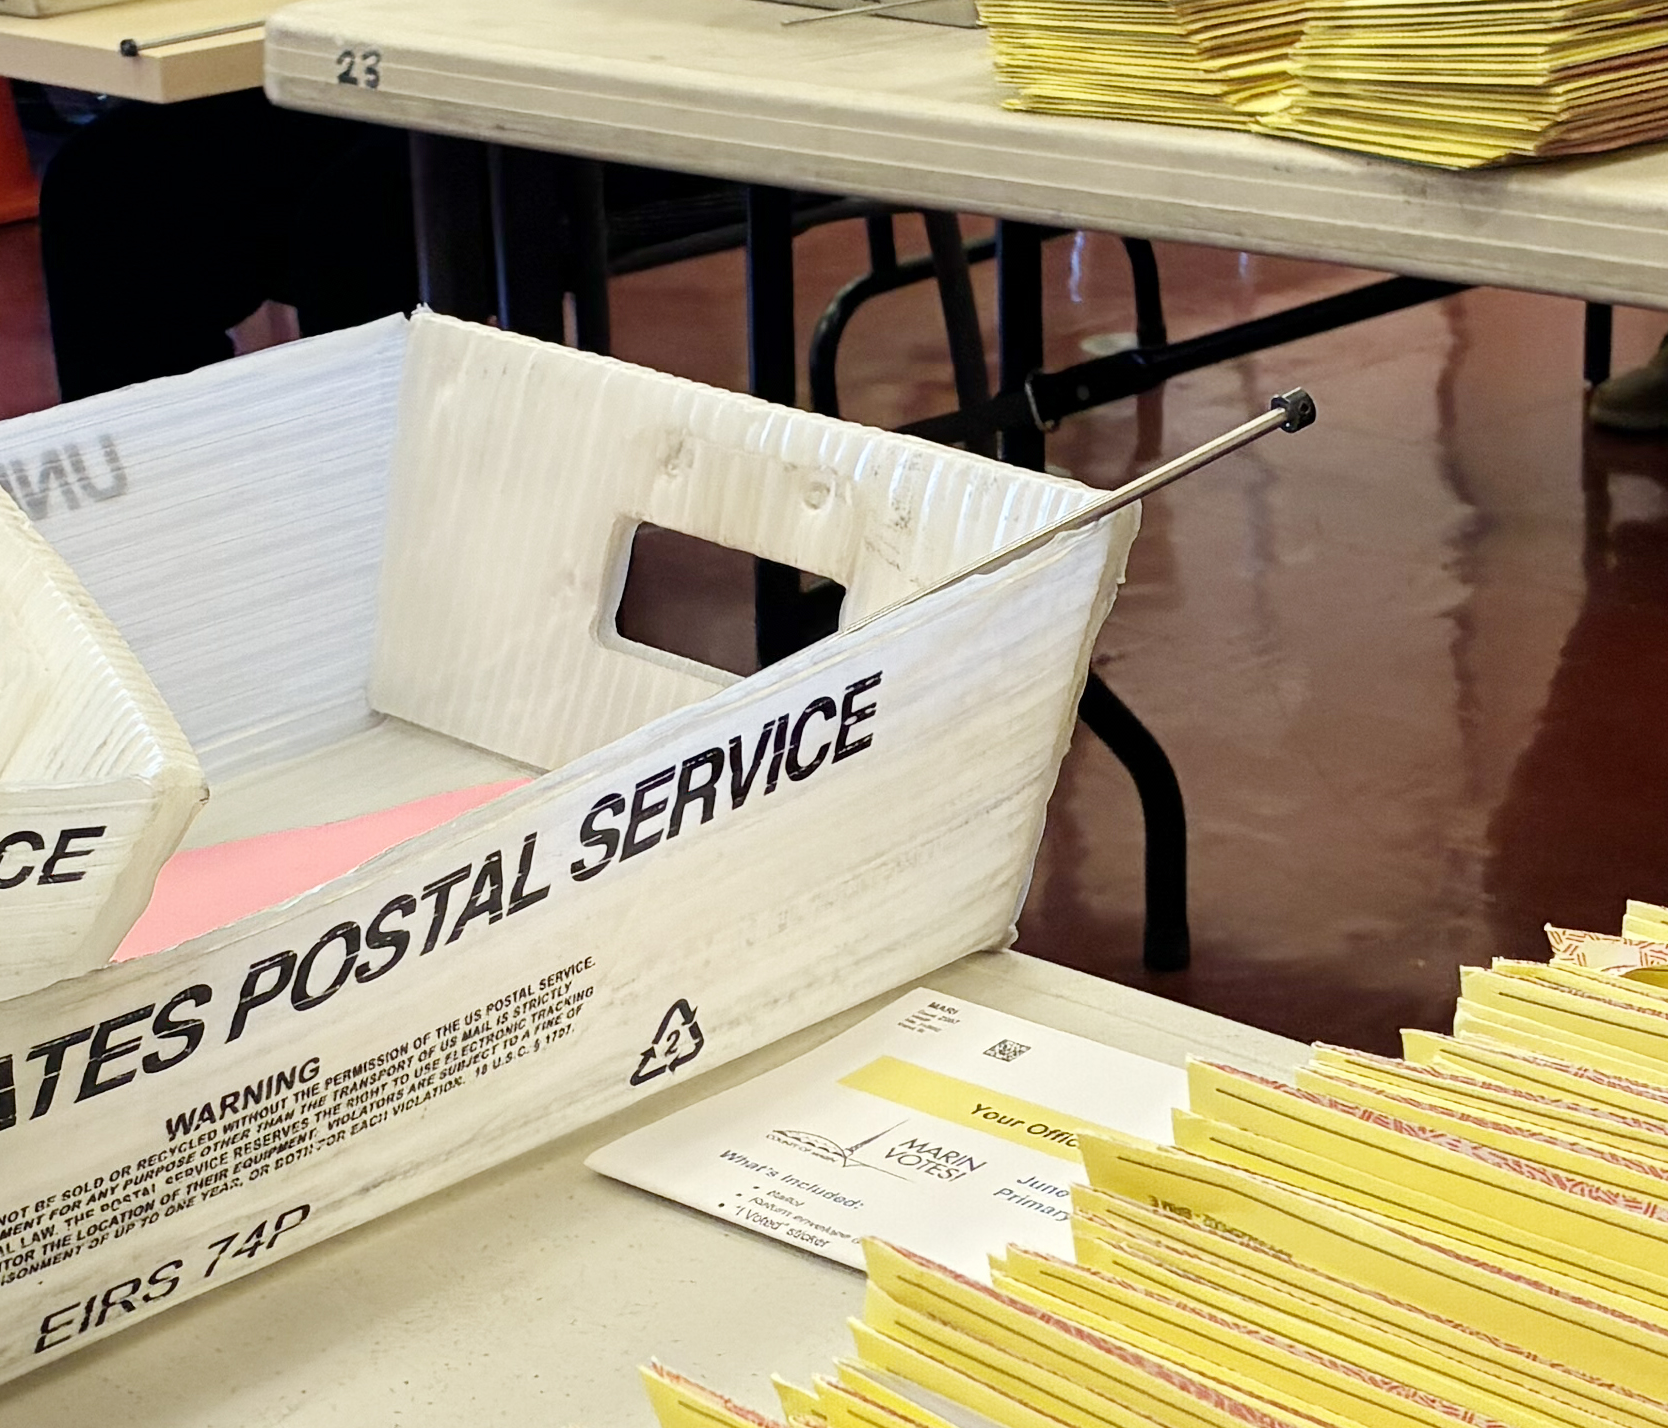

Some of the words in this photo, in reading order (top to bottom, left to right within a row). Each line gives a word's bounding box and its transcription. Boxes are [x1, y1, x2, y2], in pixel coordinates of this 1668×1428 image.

[334, 50, 382, 90] 23
[224, 830, 553, 1045] POSTAL
[570, 670, 884, 881] SERVICE
[665, 1029, 680, 1057] 2
[165, 1057, 321, 1141] WARNING
[970, 1103, 1025, 1127] Your
[885, 1147, 967, 1183] VOTES!
[898, 1138, 987, 1172] MARIN
[719, 1149, 779, 1178] What's
[781, 1174, 864, 1210] Included:
[1017, 1175, 1070, 1198] June
[993, 1187, 1071, 1222] Primary
[33, 1260, 182, 1354] EIRS
[203, 1204, 311, 1278] 74P
